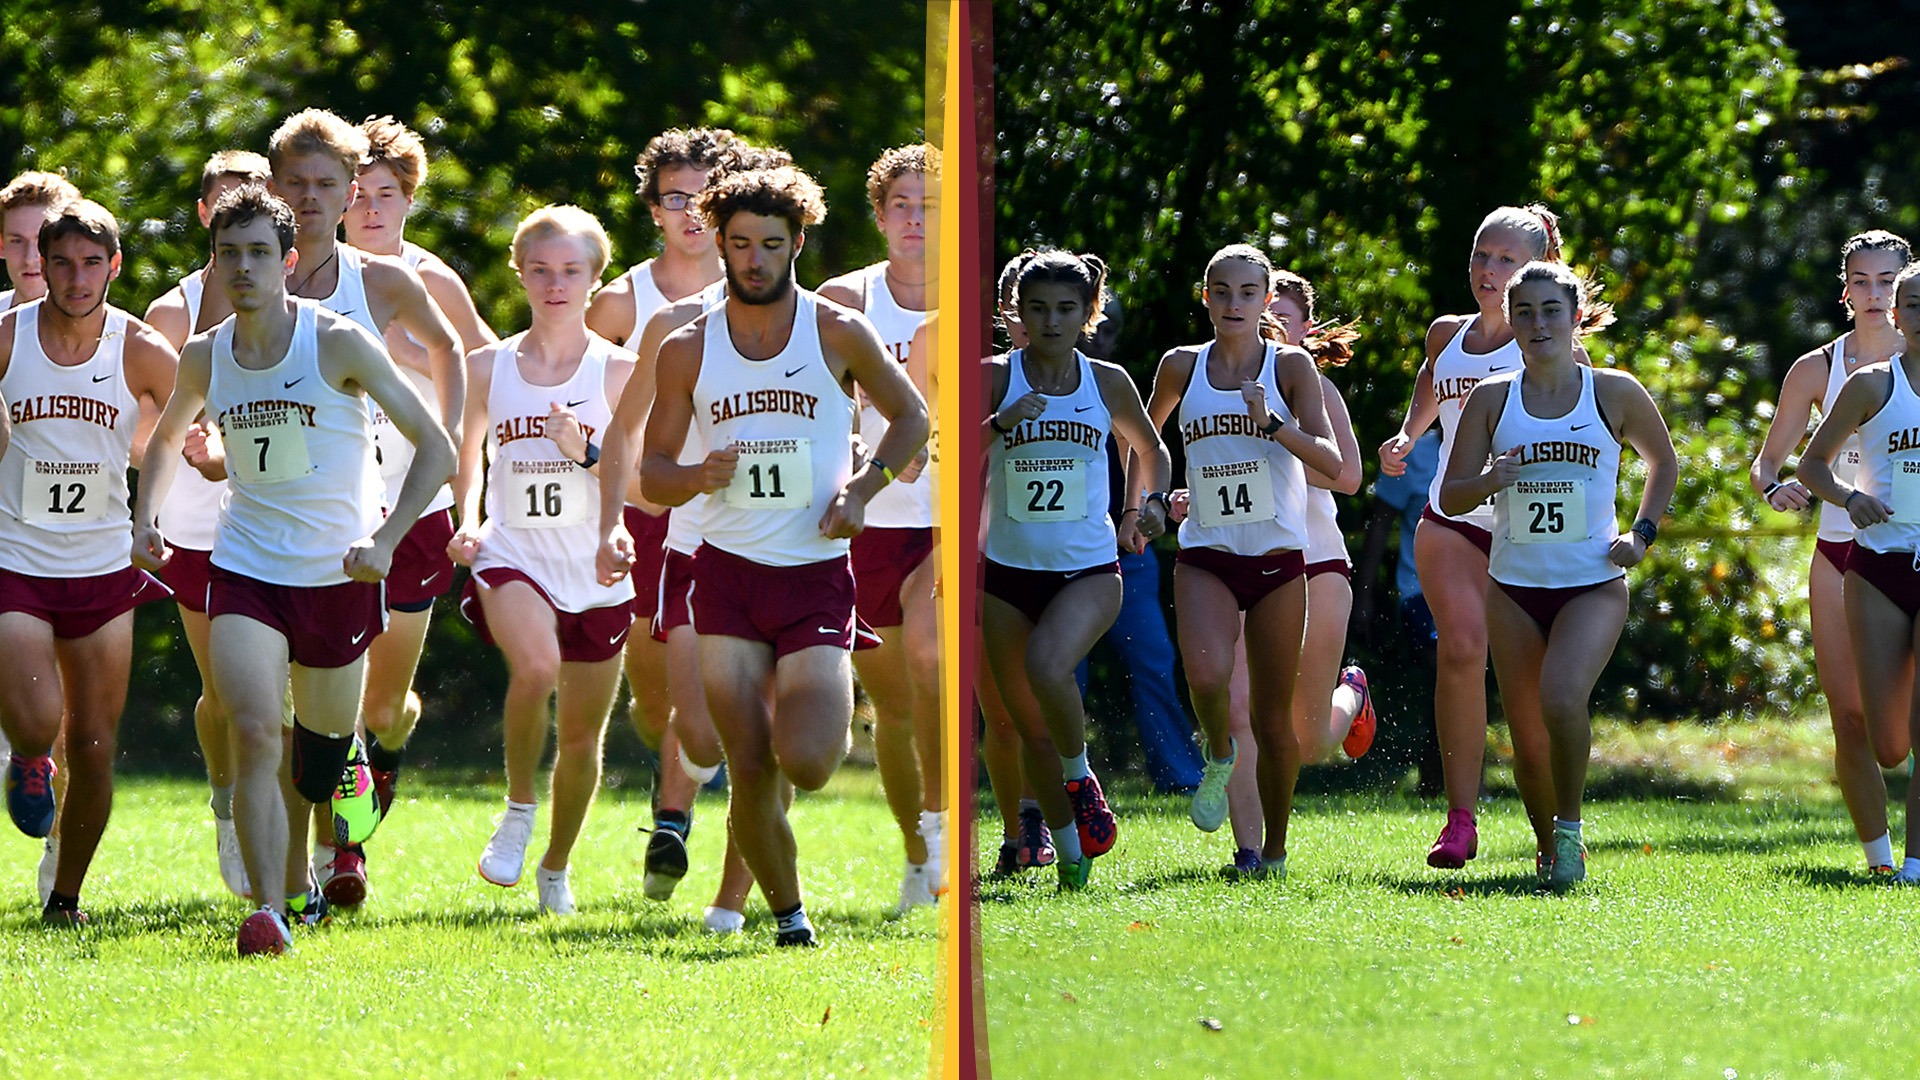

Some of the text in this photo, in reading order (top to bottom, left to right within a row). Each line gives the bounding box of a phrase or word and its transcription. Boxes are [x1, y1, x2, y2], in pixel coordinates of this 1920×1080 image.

[11, 395, 119, 431] SALISBURY
[231, 411, 288, 423] SALISBURY
[710, 389, 819, 425] SALISBURY
[232, 418, 288, 430] UNIVERSITY
[496, 416, 595, 447] SALISY
[1003, 421, 1102, 452] SALISBURY
[35, 461, 100, 469] SALISBURY
[254, 437, 270, 472] 7
[512, 460, 574, 468] SALISBURY
[739, 446, 798, 455] NIVERSITY
[1519, 442, 1600, 469] LISBURY
[35, 467, 100, 475] UNIVERSITY
[512, 467, 574, 475] UNIVERSITY
[748, 464, 785, 498] 11
[1014, 465, 1074, 473] UNIVERSITY
[1202, 461, 1258, 473] SALISBURY
[1202, 467, 1259, 479] UNIVERSITY
[48, 483, 86, 514] 12
[526, 482, 562, 517] 16
[1027, 480, 1065, 512] 22
[1217, 483, 1253, 516] 14
[1528, 502, 1564, 533] 25
